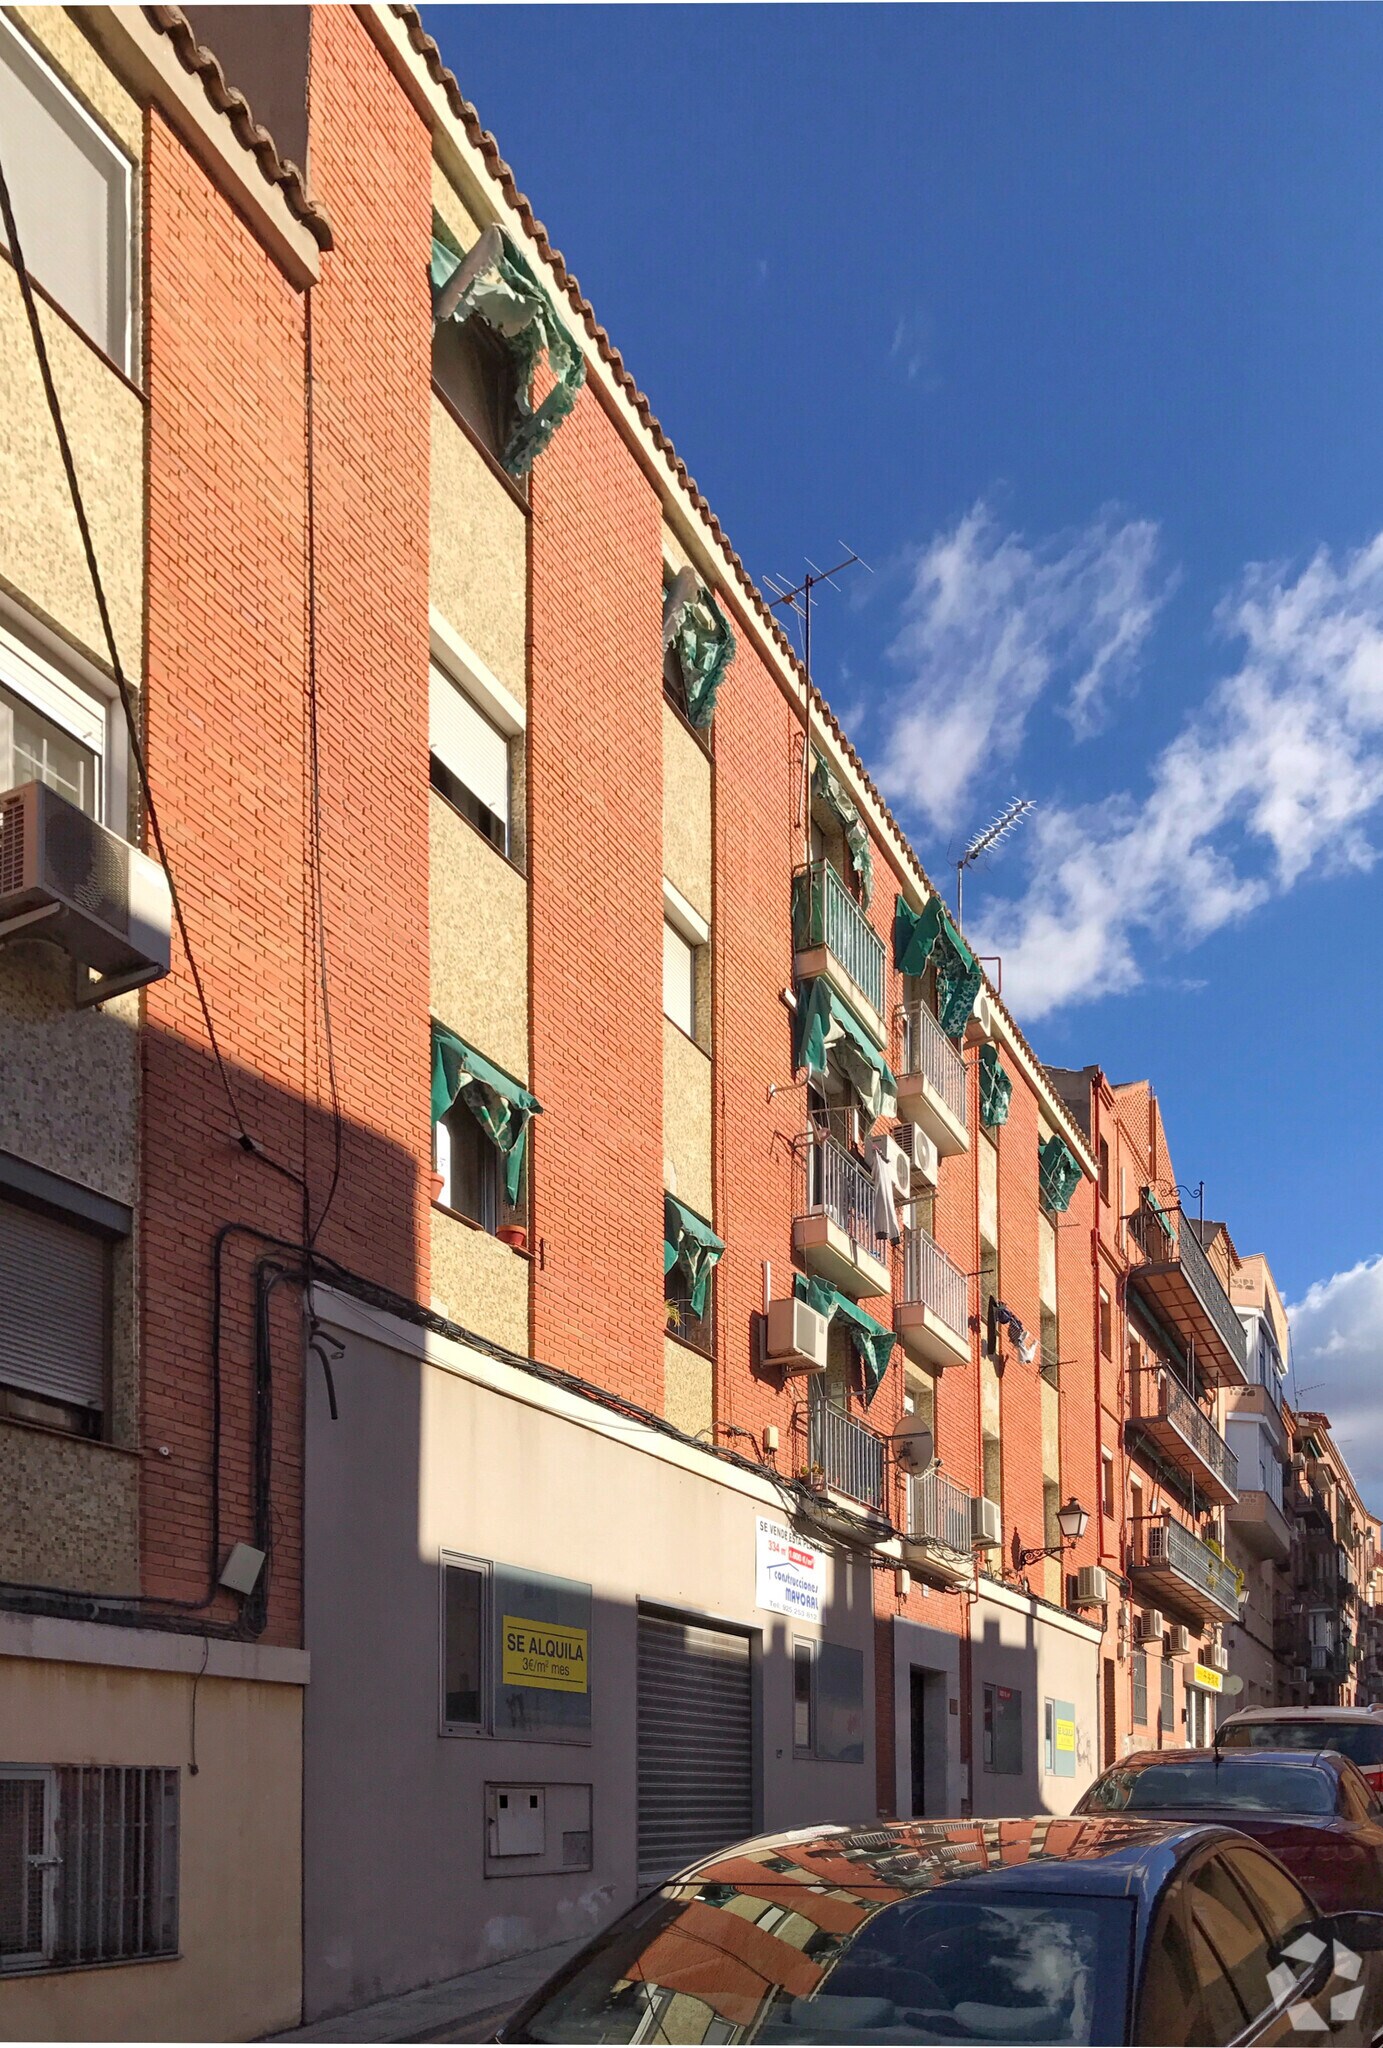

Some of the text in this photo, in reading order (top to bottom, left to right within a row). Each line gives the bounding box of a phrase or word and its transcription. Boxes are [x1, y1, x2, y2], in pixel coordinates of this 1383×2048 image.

[759, 1520, 768, 1533] SE
[770, 1525, 788, 1540] VENDE
[768, 1540, 780, 1552] 334
[785, 1587, 819, 1610] MAYORAL
[507, 1633, 584, 1662] SE ALQUILA
[522, 1657, 570, 1676] 3€/m² mes
